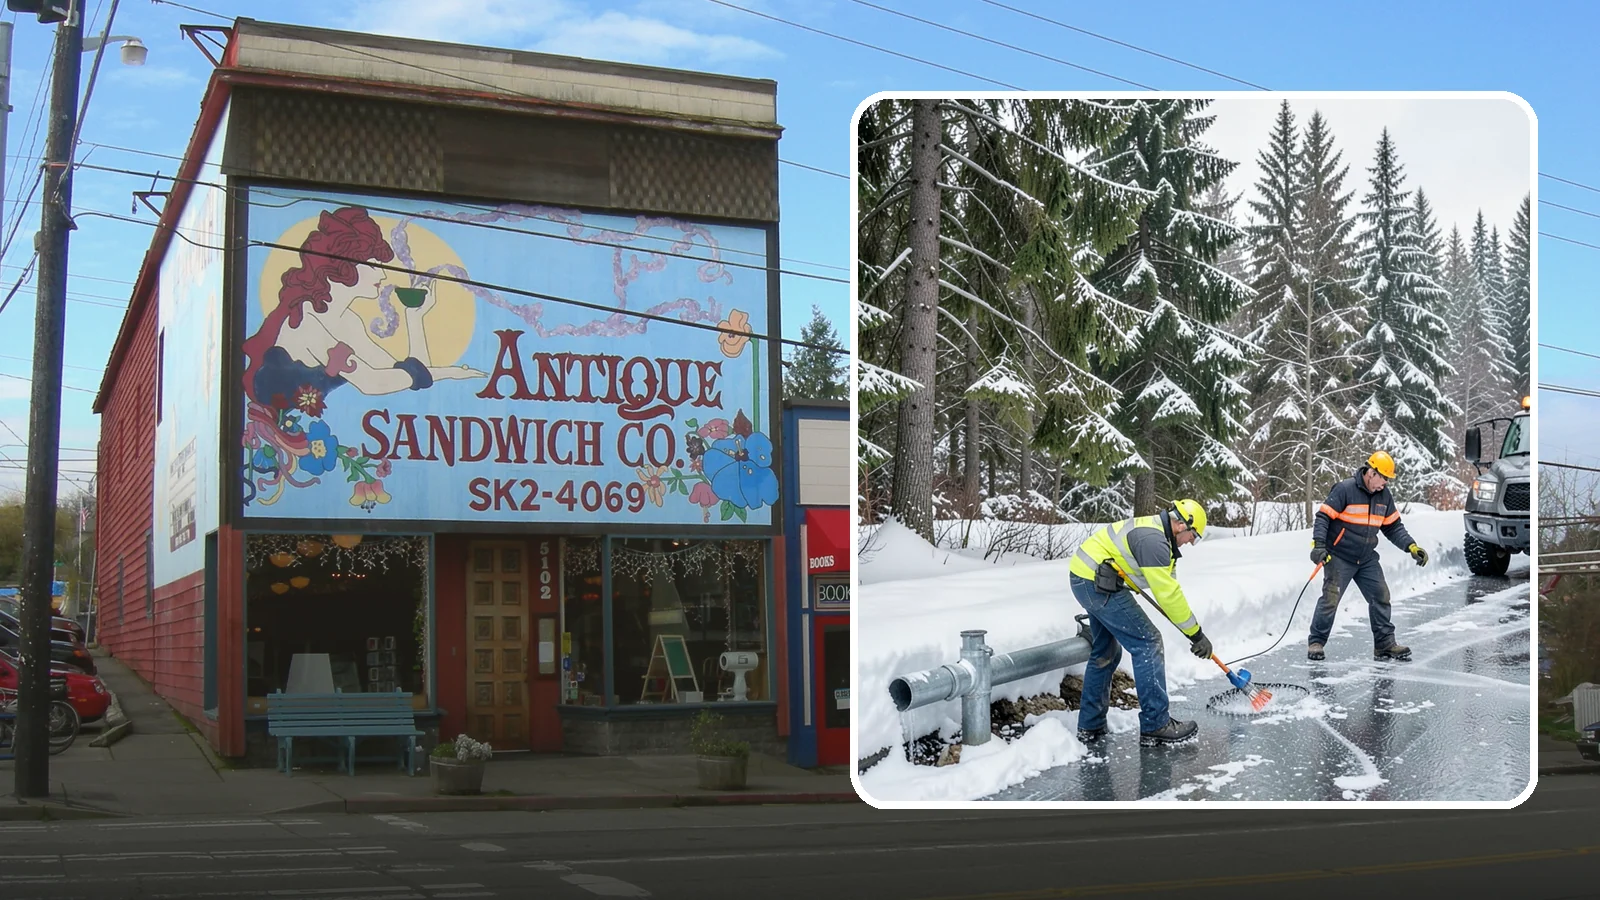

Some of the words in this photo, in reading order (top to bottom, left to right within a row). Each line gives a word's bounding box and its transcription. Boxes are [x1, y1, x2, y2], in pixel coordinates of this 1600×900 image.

[476, 329, 723, 420] ANTIQUE
[361, 408, 604, 467] SANDWICH
[617, 422, 685, 468] CO.
[468, 477, 645, 513] SK2-4069
[809, 555, 835, 569] BOOKS
